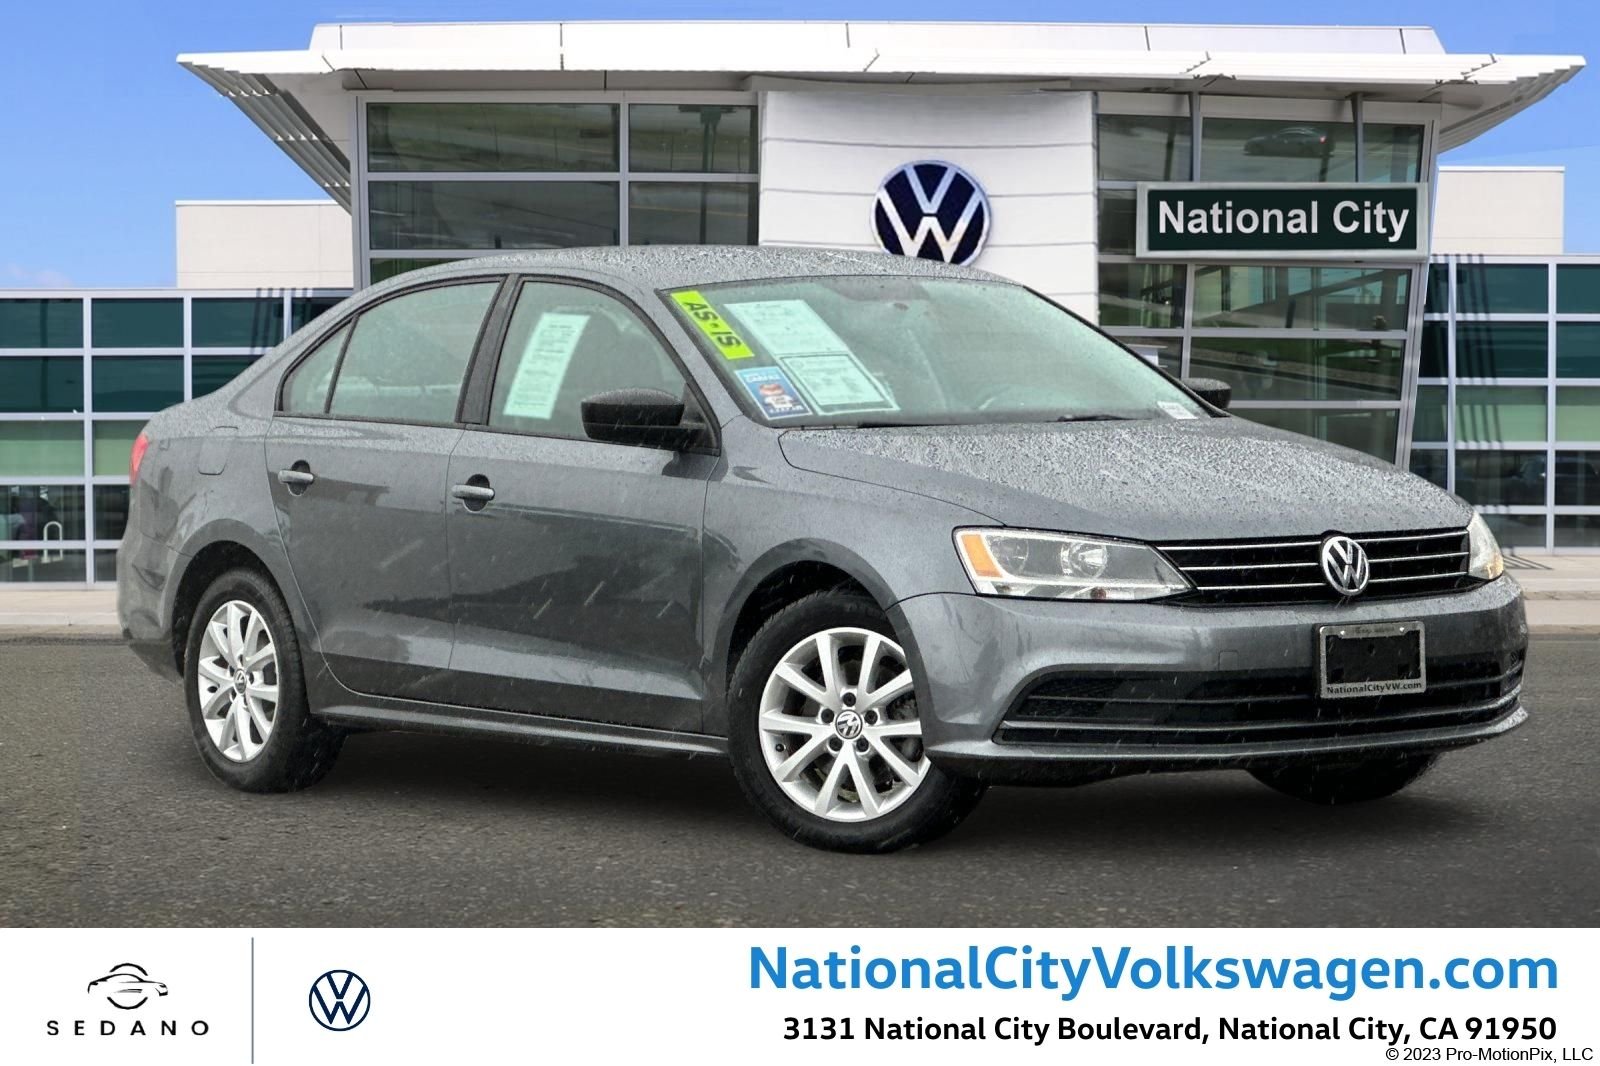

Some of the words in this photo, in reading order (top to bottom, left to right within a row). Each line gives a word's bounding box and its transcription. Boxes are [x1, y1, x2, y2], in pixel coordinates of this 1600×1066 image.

[1158, 200, 1318, 234] National
[1332, 200, 1409, 243] City
[1326, 682, 1422, 695] NationalCityVW.com
